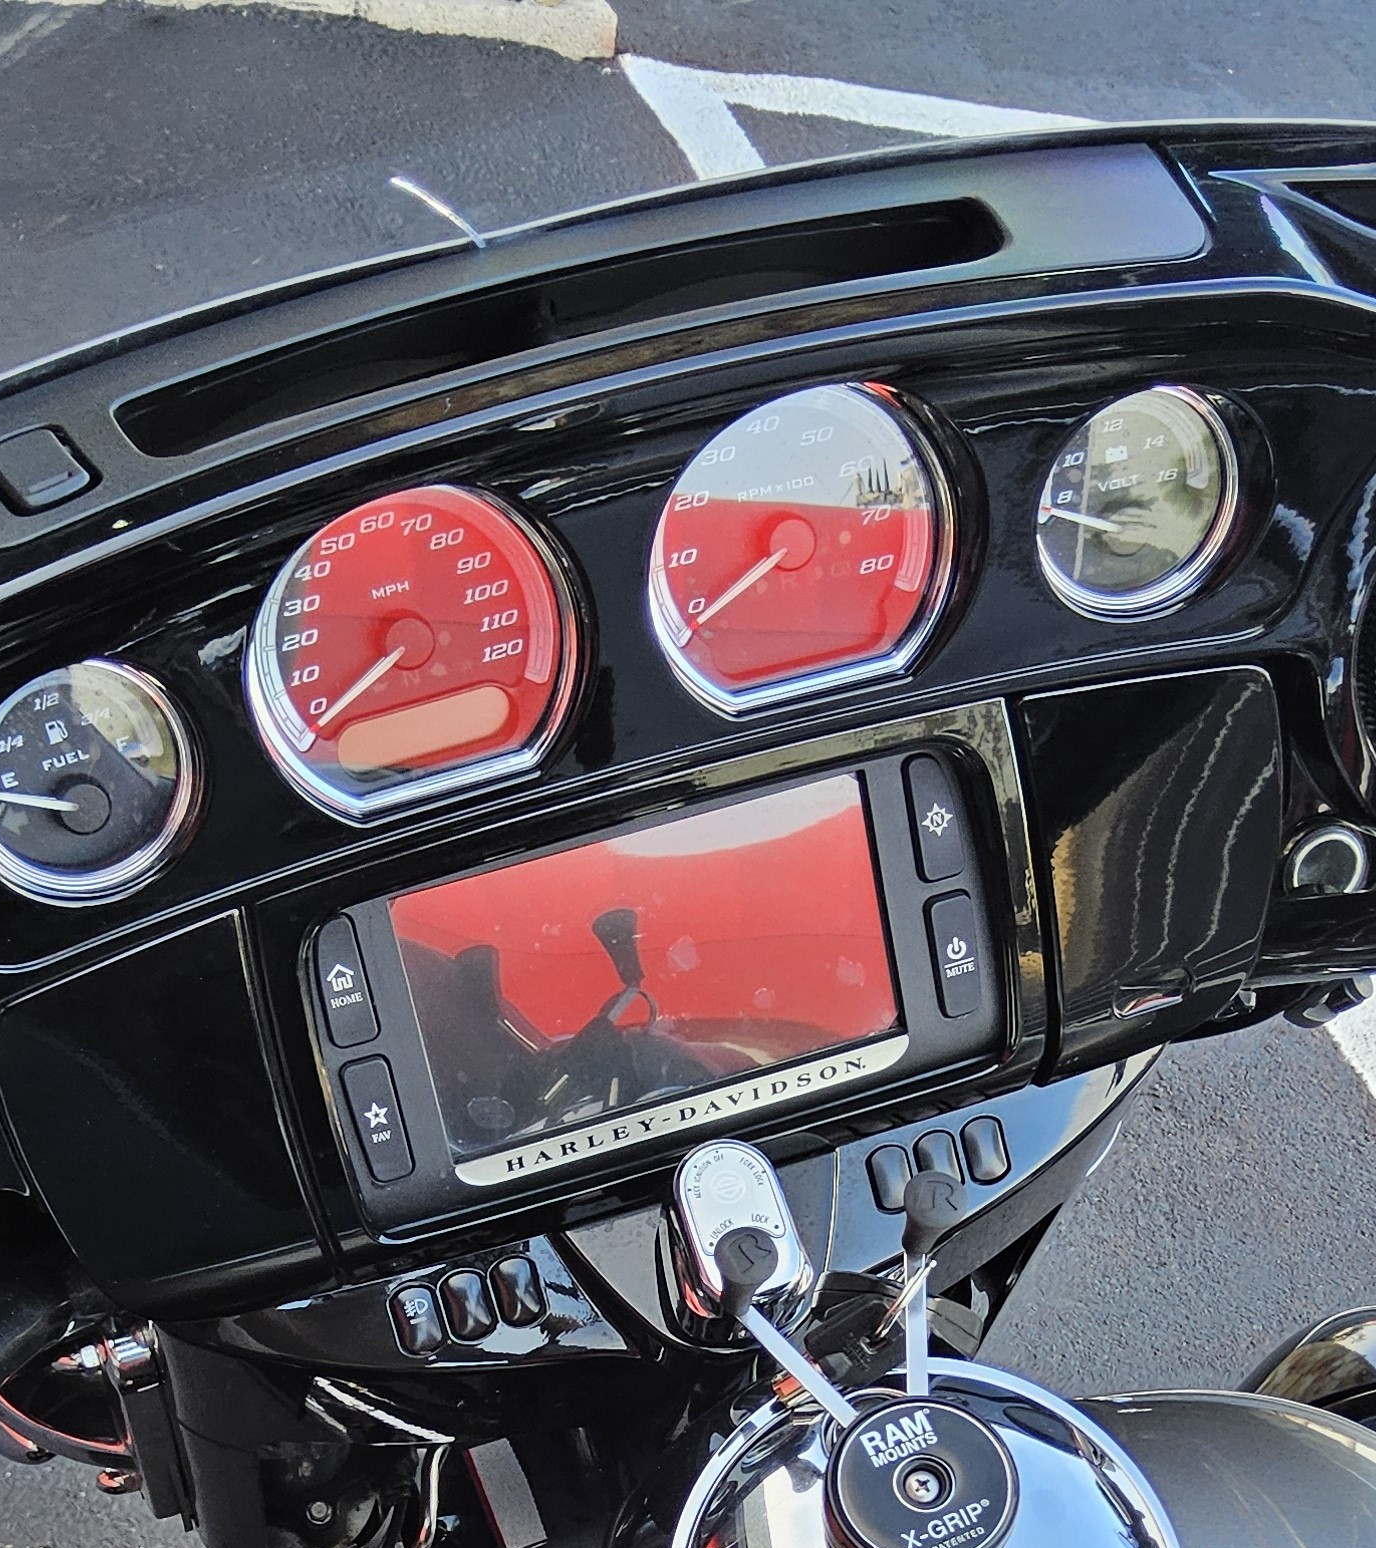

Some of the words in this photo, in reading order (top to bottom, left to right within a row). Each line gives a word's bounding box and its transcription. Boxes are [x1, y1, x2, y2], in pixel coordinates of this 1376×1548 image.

[746, 415, 780, 435] 40
[1102, 418, 1124, 432] 12
[800, 426, 833, 447] 50
[1143, 435, 1165, 450] 14
[701, 446, 736, 467] 30
[840, 455, 873, 477] 60
[1062, 452, 1084, 468] 10
[1097, 474, 1140, 492] VOLT
[1156, 468, 1178, 483] 16
[674, 491, 710, 511] 20
[737, 484, 774, 503] RPM
[1057, 490, 1073, 504] 8
[359, 512, 395, 534] 60
[401, 513, 432, 536] 70
[861, 504, 891, 526] 70
[320, 533, 355, 556] 50
[430, 528, 464, 550] 80
[456, 552, 491, 574] 90
[669, 548, 698, 569] 10
[859, 554, 894, 575] 80
[294, 561, 331, 582] 40
[371, 580, 410, 600] MPH
[463, 580, 508, 605] 100
[283, 595, 320, 617] 30
[688, 598, 706, 614] 0
[479, 609, 519, 632] 110
[281, 629, 318, 652] 20
[482, 639, 523, 663] 120
[291, 665, 320, 687] 10
[33, 693, 59, 710] 1/2
[309, 698, 327, 715] 0
[42, 749, 90, 771] FUEL
[0, 772, 19, 789] E
[946, 961, 975, 979] MUTE
[330, 992, 364, 1009] HOME
[371, 1130, 392, 1144] FAV
[926, 1180, 958, 1211] R
[709, 1217, 735, 1241] UNLOCK
[751, 1213, 770, 1225] LOCK
[871, 1431, 938, 1468] MOUNTS
